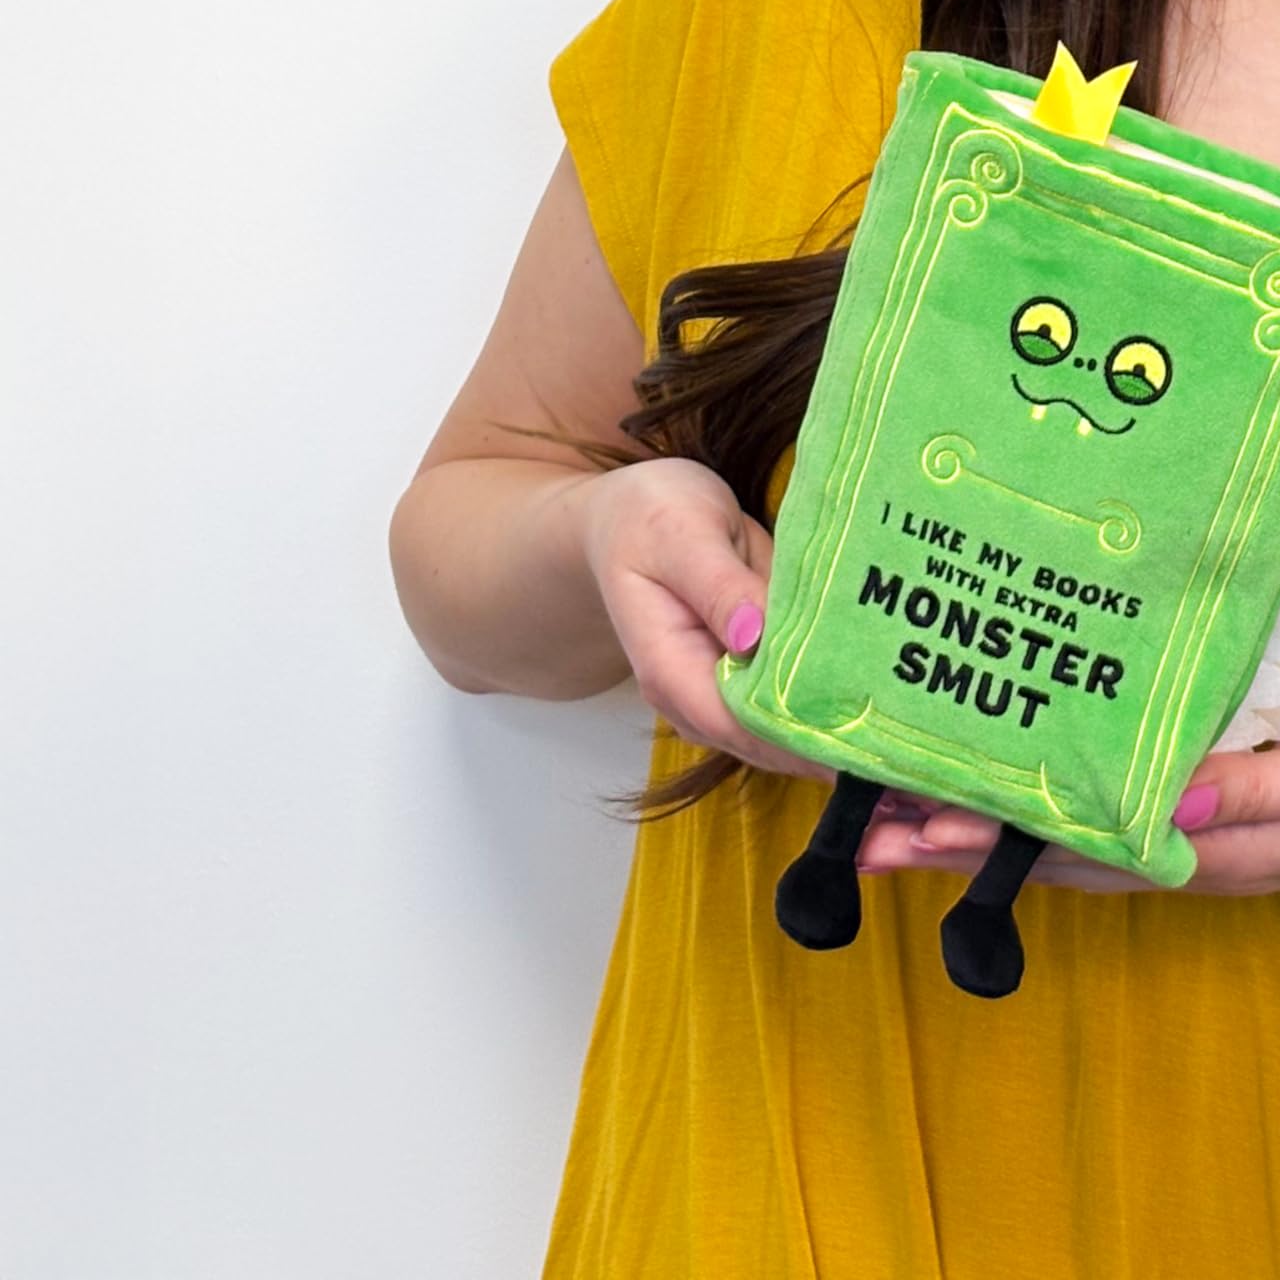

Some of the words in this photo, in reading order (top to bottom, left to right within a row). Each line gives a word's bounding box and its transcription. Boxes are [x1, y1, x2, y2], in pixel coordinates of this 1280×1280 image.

[881, 501, 891, 525] I
[901, 511, 967, 555] LIKE
[977, 542, 1022, 578] MY
[1032, 565, 1143, 619] BOOKS
[926, 555, 987, 597] WITH
[994, 586, 1078, 632] EXTRA
[857, 564, 1125, 701] MONSTER
[892, 641, 1051, 729] SMUT
